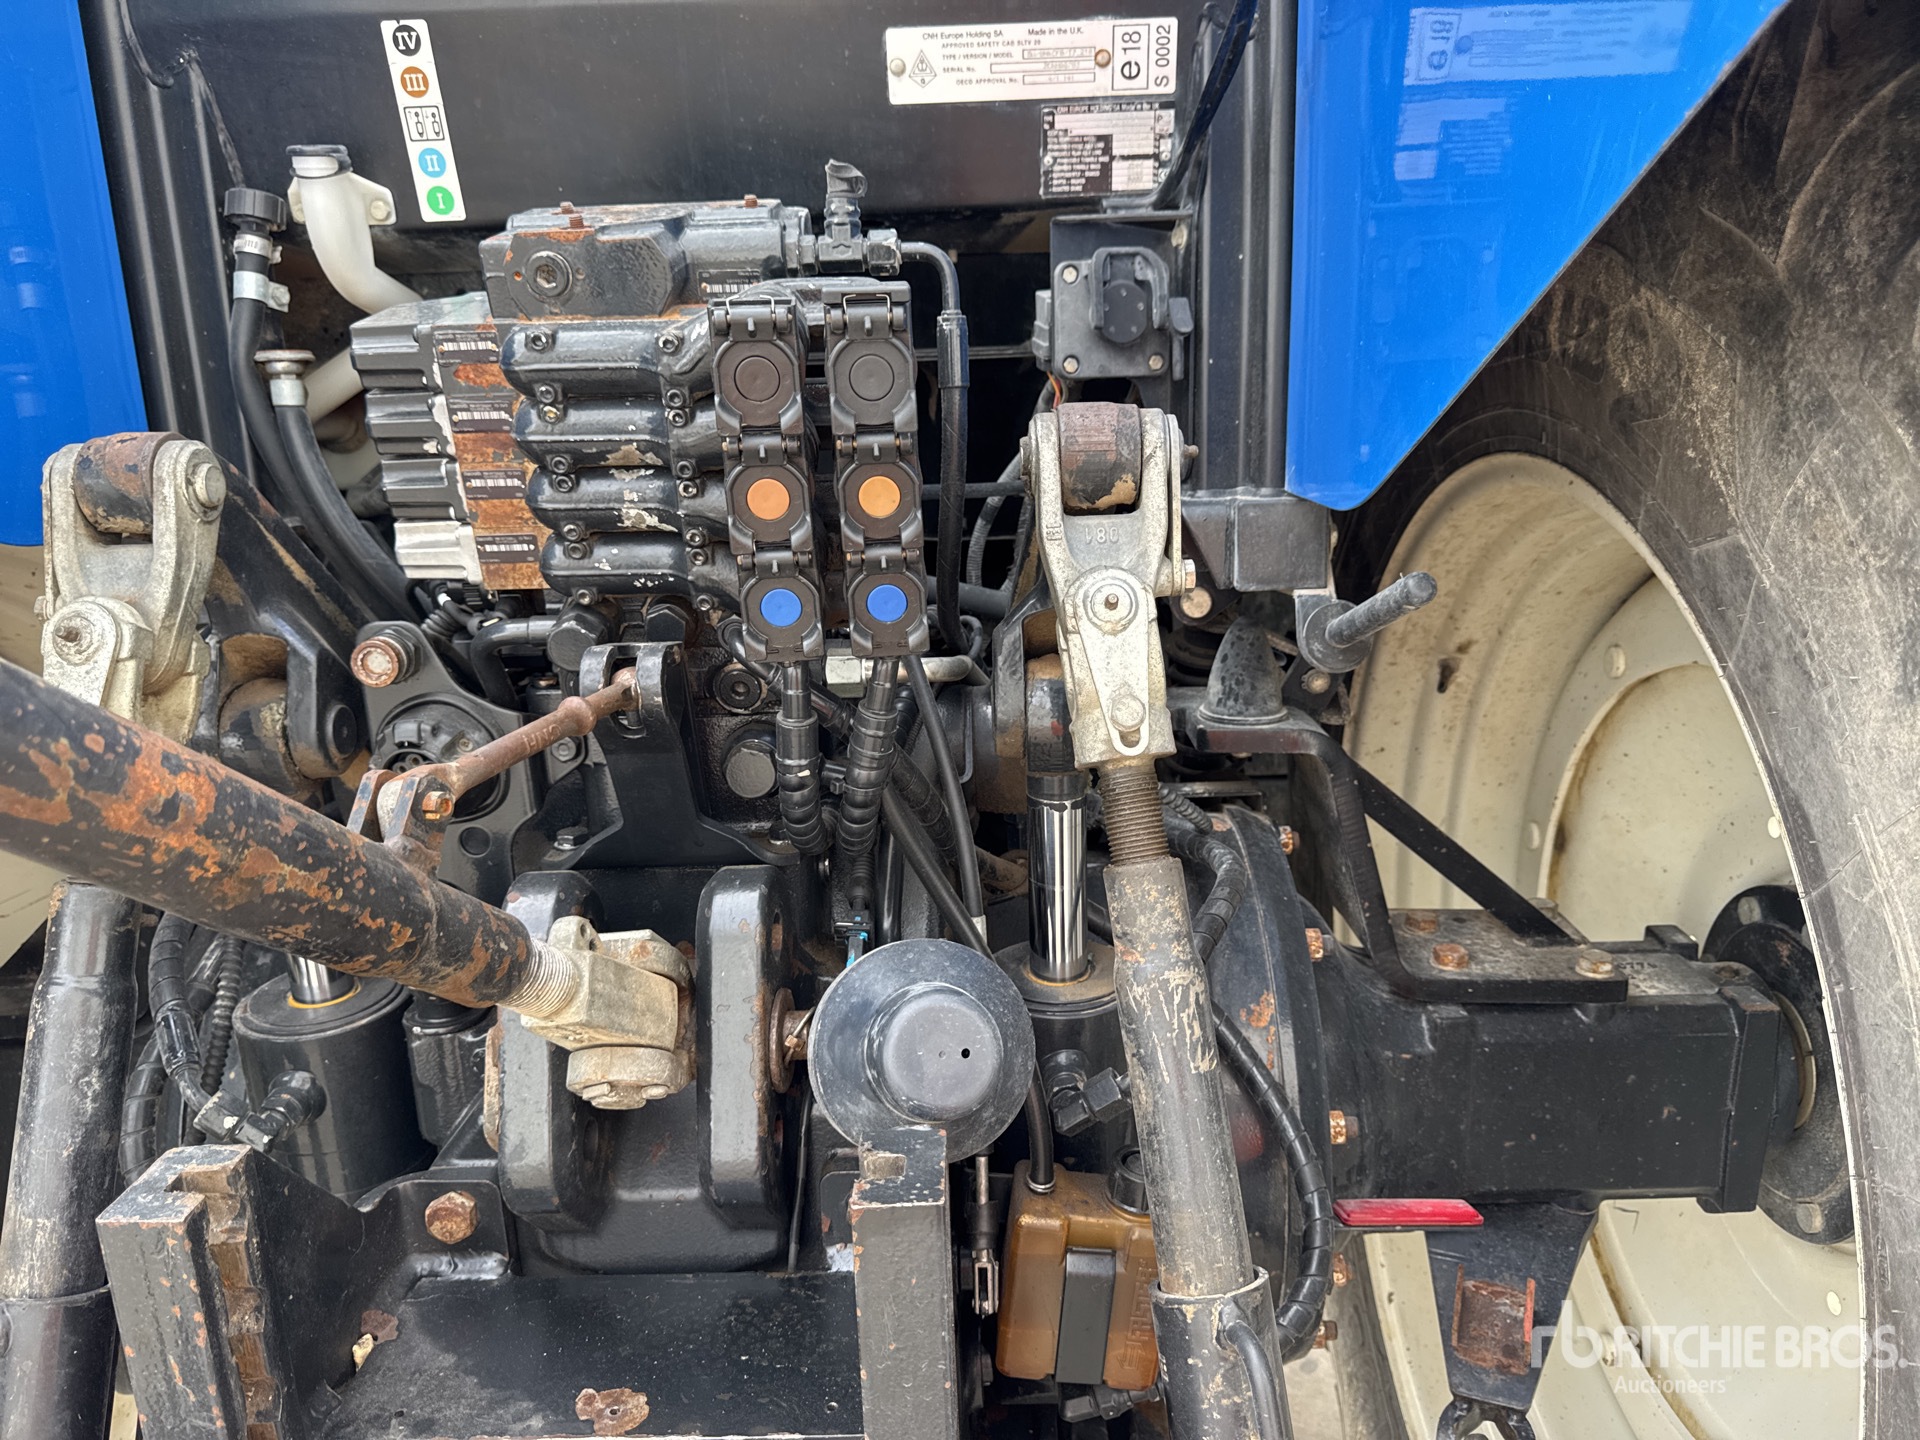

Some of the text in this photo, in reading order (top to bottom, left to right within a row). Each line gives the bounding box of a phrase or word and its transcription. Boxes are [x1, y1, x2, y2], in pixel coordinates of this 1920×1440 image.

[922, 29, 1004, 40] CNH Europe Holding SA
[1028, 28, 1047, 36] Made
[1057, 27, 1068, 35] the
[1070, 26, 1084, 34] U.K.
[395, 31, 418, 50] IV
[1154, 24, 1171, 87] S 0002
[403, 73, 427, 92] III
[424, 154, 440, 172] II
